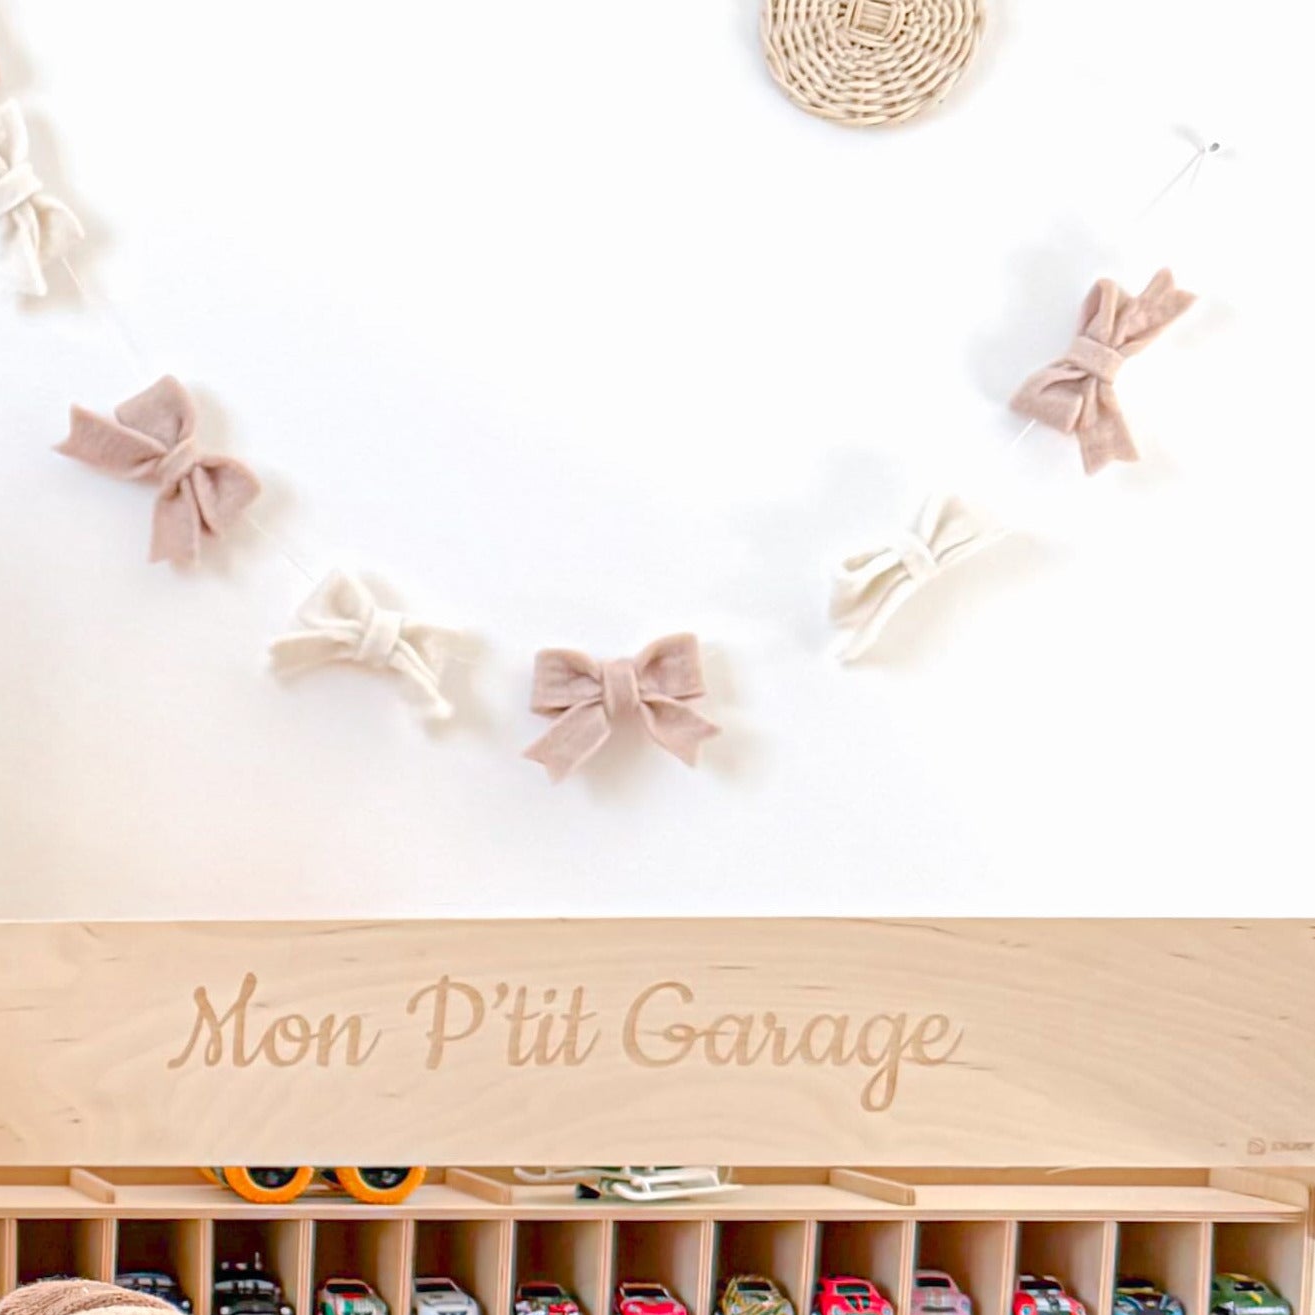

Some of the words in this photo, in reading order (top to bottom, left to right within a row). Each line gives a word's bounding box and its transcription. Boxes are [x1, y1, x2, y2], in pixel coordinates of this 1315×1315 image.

[167, 972, 380, 1069] Mon
[406, 975, 601, 1070] P'tit
[622, 981, 963, 1112] Garage
